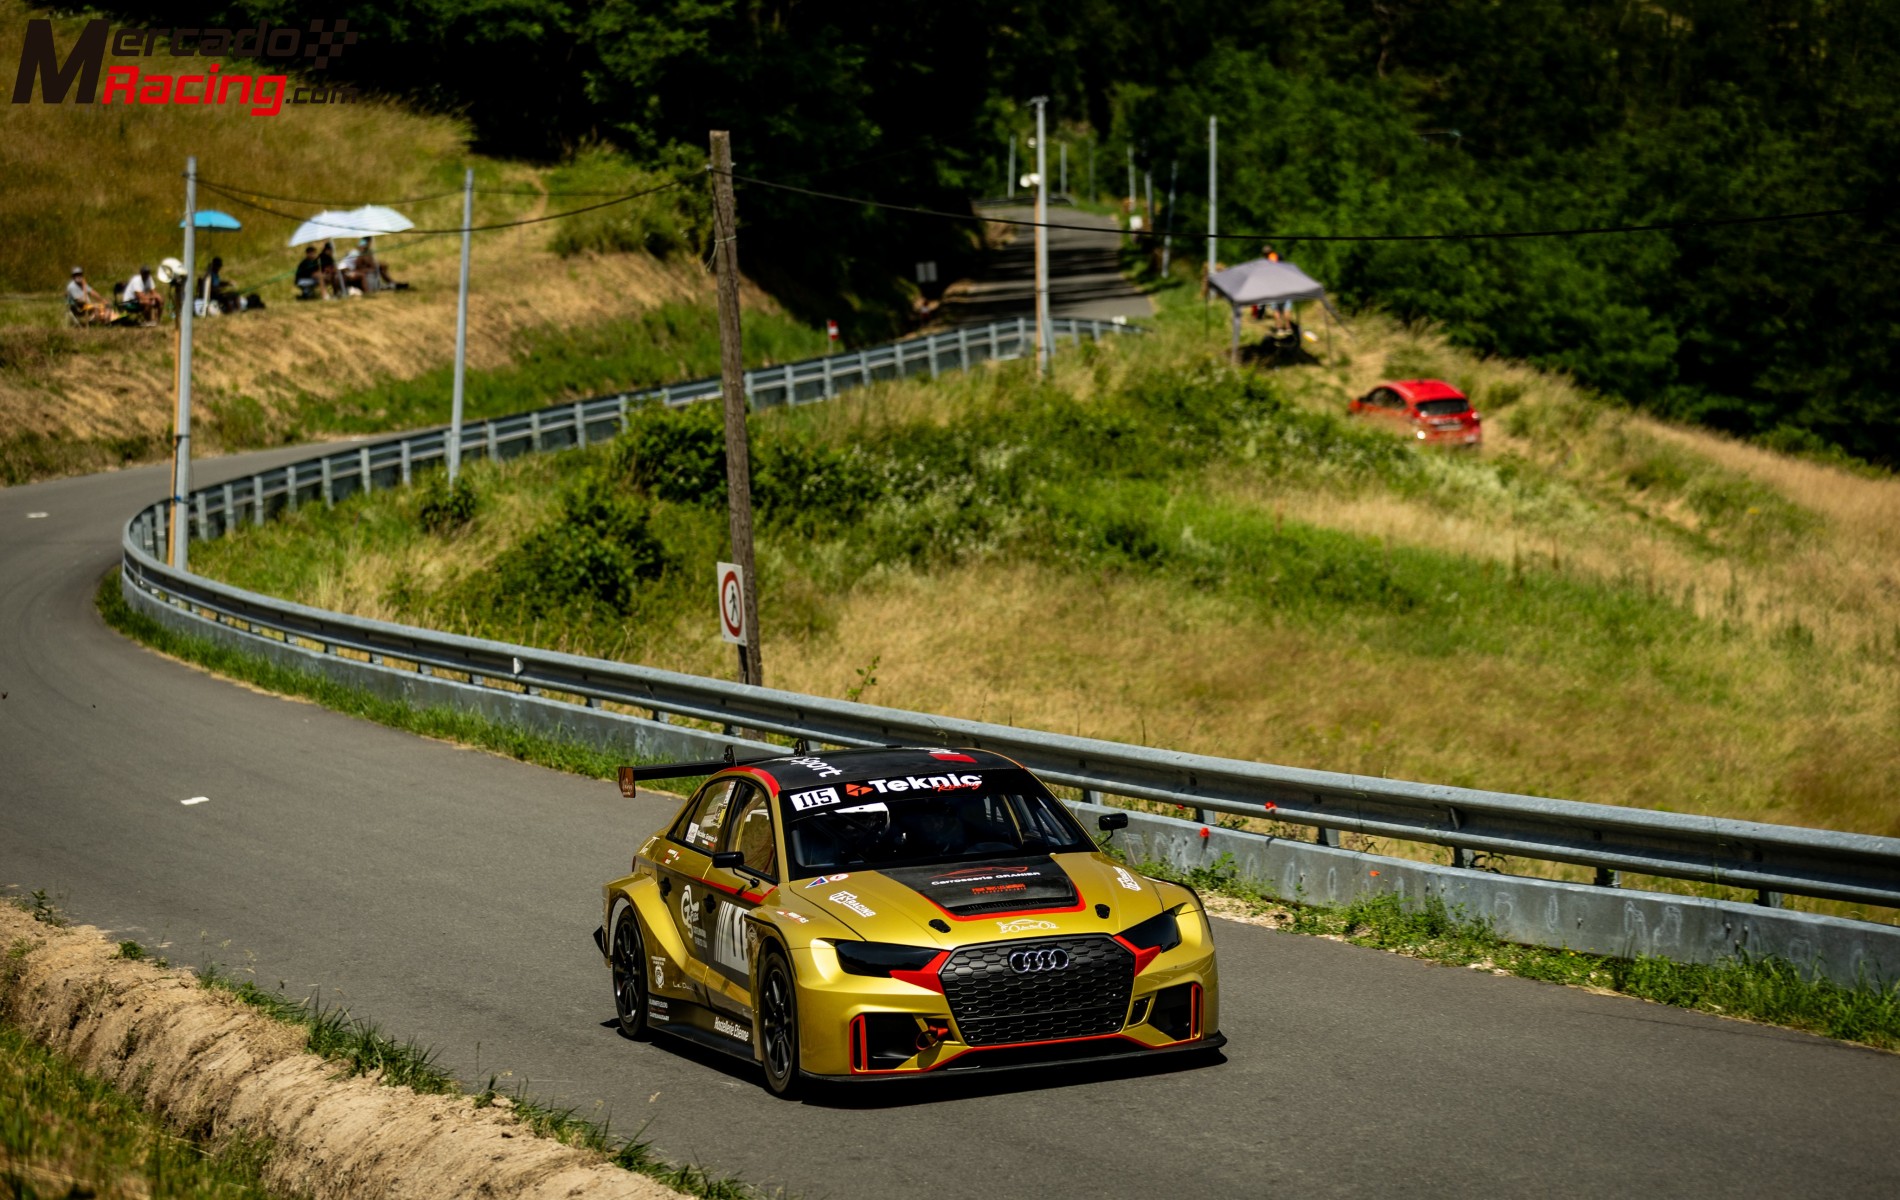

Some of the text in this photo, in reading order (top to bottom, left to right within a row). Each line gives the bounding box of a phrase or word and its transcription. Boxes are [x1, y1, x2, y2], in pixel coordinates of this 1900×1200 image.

[867, 773, 983, 794] Teknic
[797, 789, 832, 808] 115
[931, 871, 1041, 886] Carrosserie GRANIER
